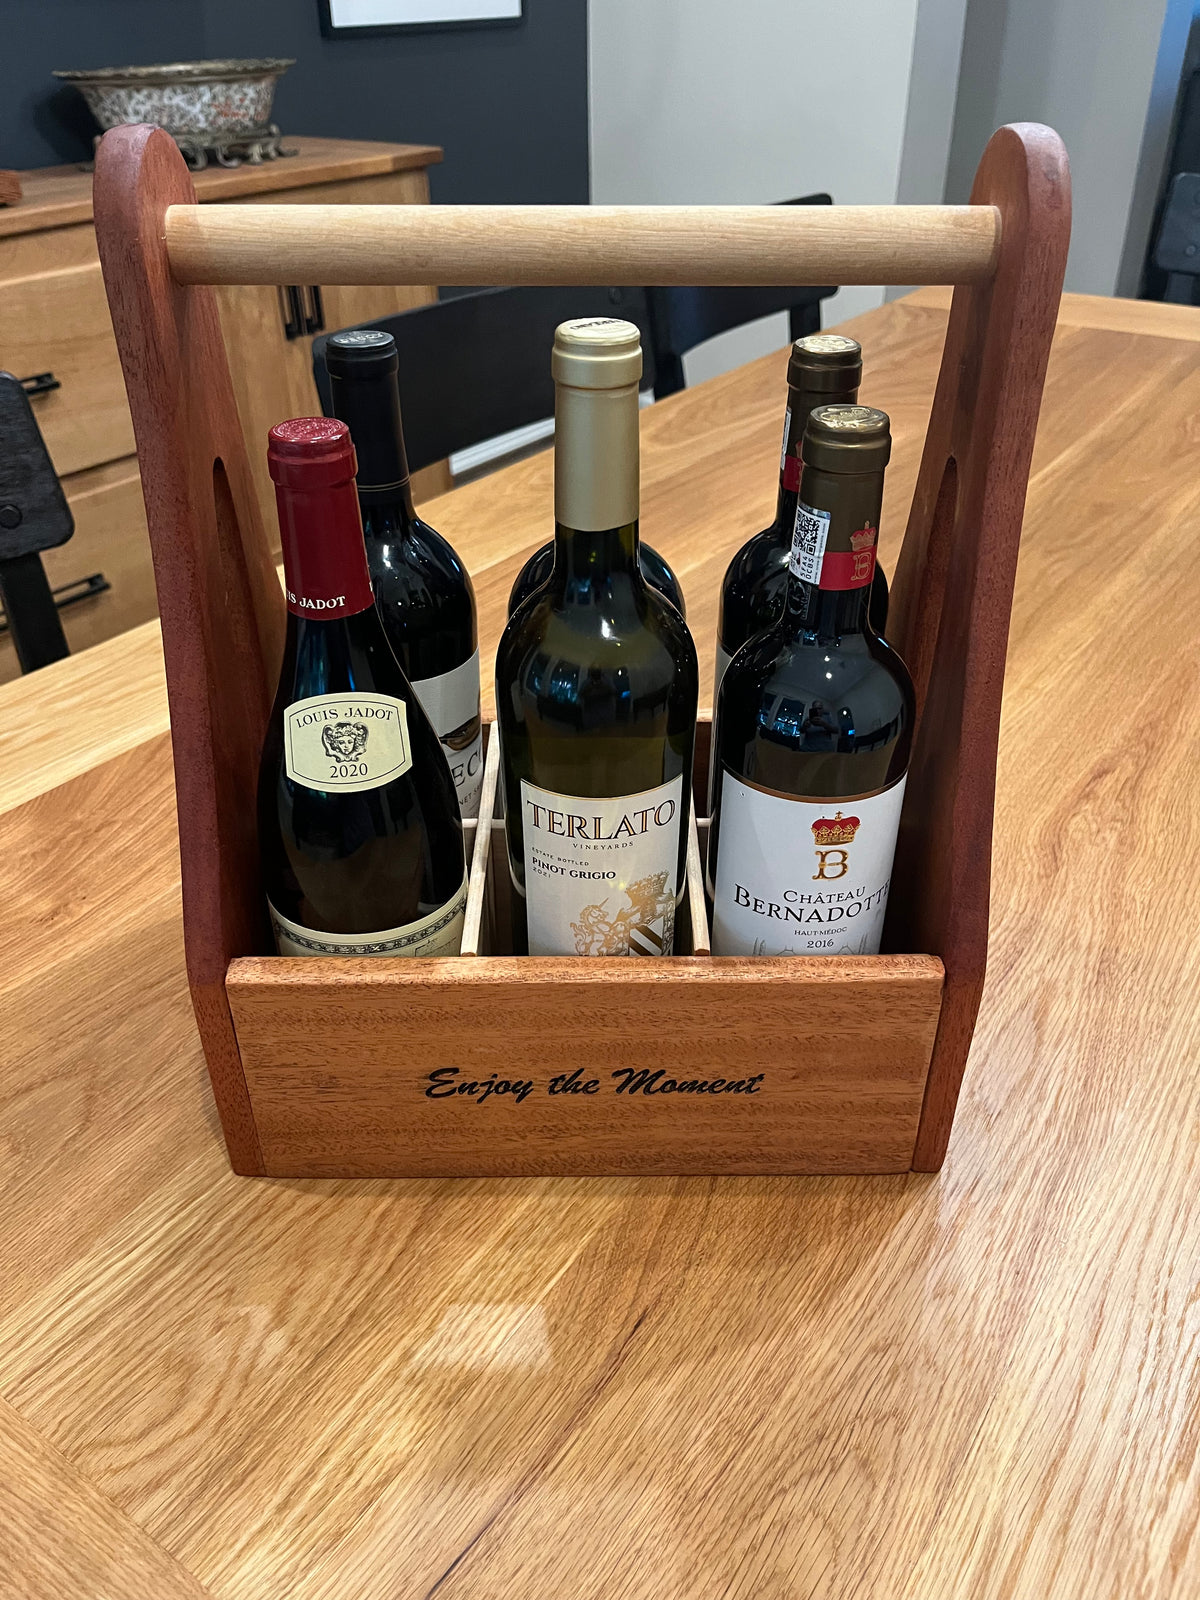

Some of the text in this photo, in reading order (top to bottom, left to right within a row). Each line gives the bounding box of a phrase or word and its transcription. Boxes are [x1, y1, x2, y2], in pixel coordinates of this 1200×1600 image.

[287, 589, 346, 610] IS JADOT
[296, 707, 394, 728] LOUIS JADOT
[330, 763, 368, 778] 2020
[527, 799, 676, 840] TERLATO
[573, 841, 634, 851] VINEYARDS
[531, 847, 590, 867] ESTATE BOTTLED
[811, 849, 849, 881] B
[532, 857, 617, 880] PINOT GRIGIO
[532, 867, 551, 878] 2021
[783, 886, 866, 904] CHÂTEAU
[807, 939, 834, 949] 2016
[425, 1067, 766, 1104] Enjoy the Moment
